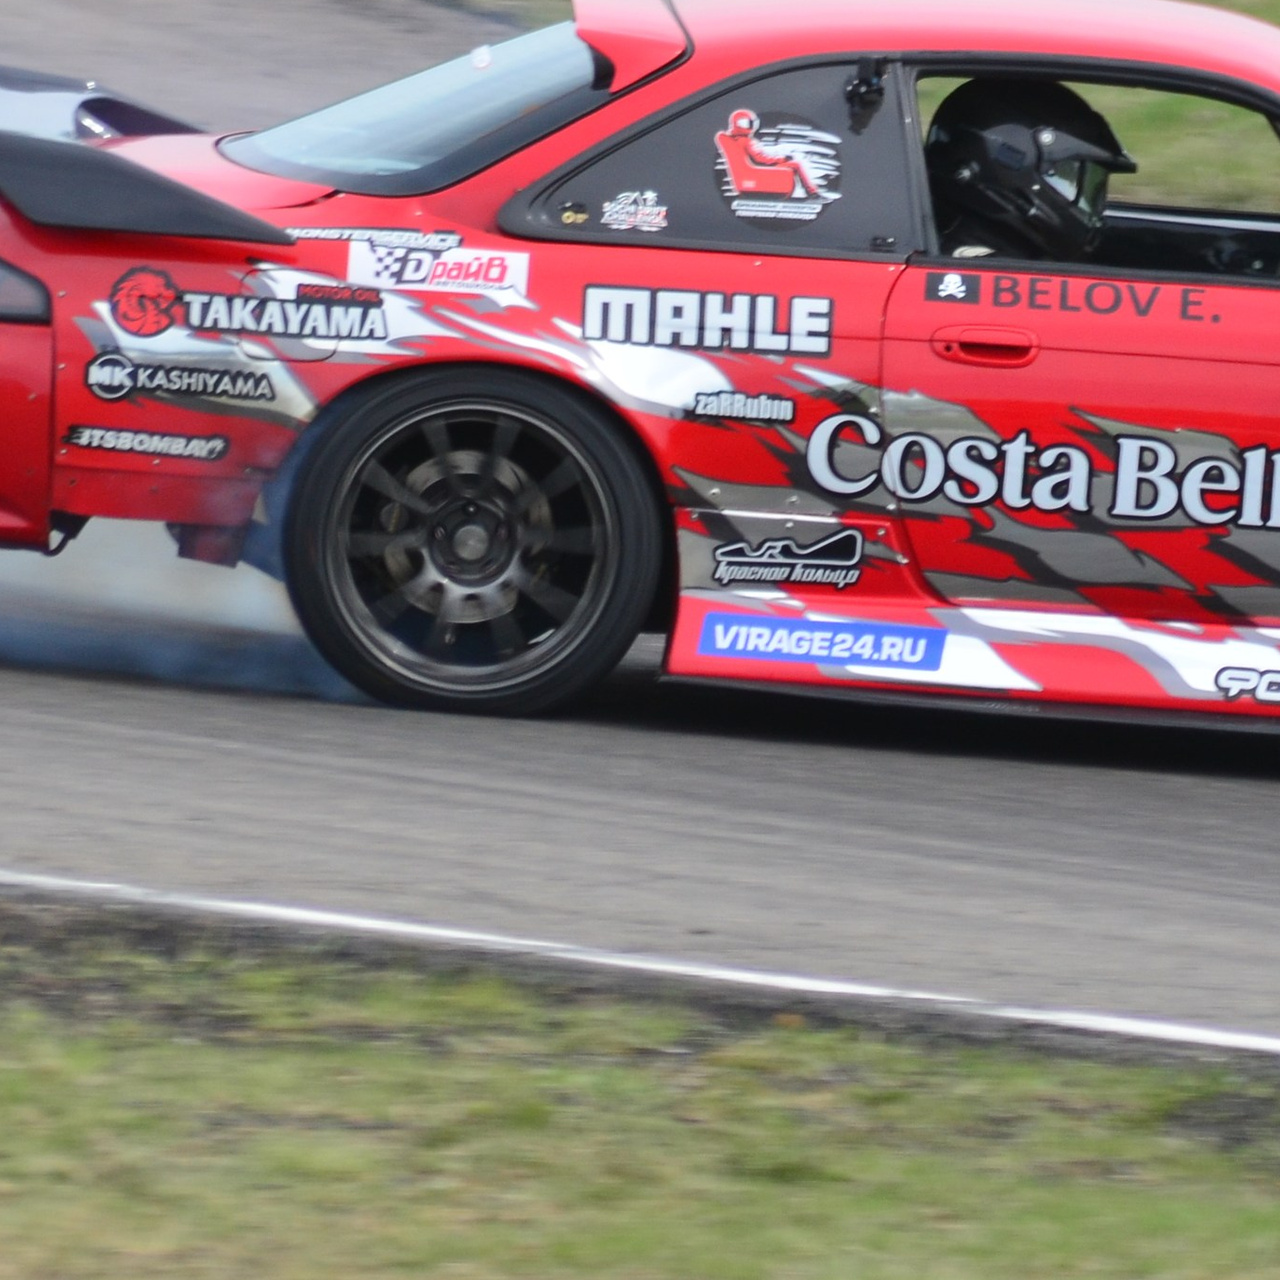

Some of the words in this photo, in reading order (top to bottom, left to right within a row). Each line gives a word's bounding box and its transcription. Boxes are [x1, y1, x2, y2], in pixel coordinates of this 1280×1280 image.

[183, 293, 388, 338] TAKAYAMA
[583, 285, 831, 354] MAHLE
[993, 274, 1160, 317] BELOV
[1179, 287, 1221, 323] E.
[88, 366, 134, 386] MK
[137, 368, 274, 399] KASHIYAMA
[806, 413, 1090, 512] Costa
